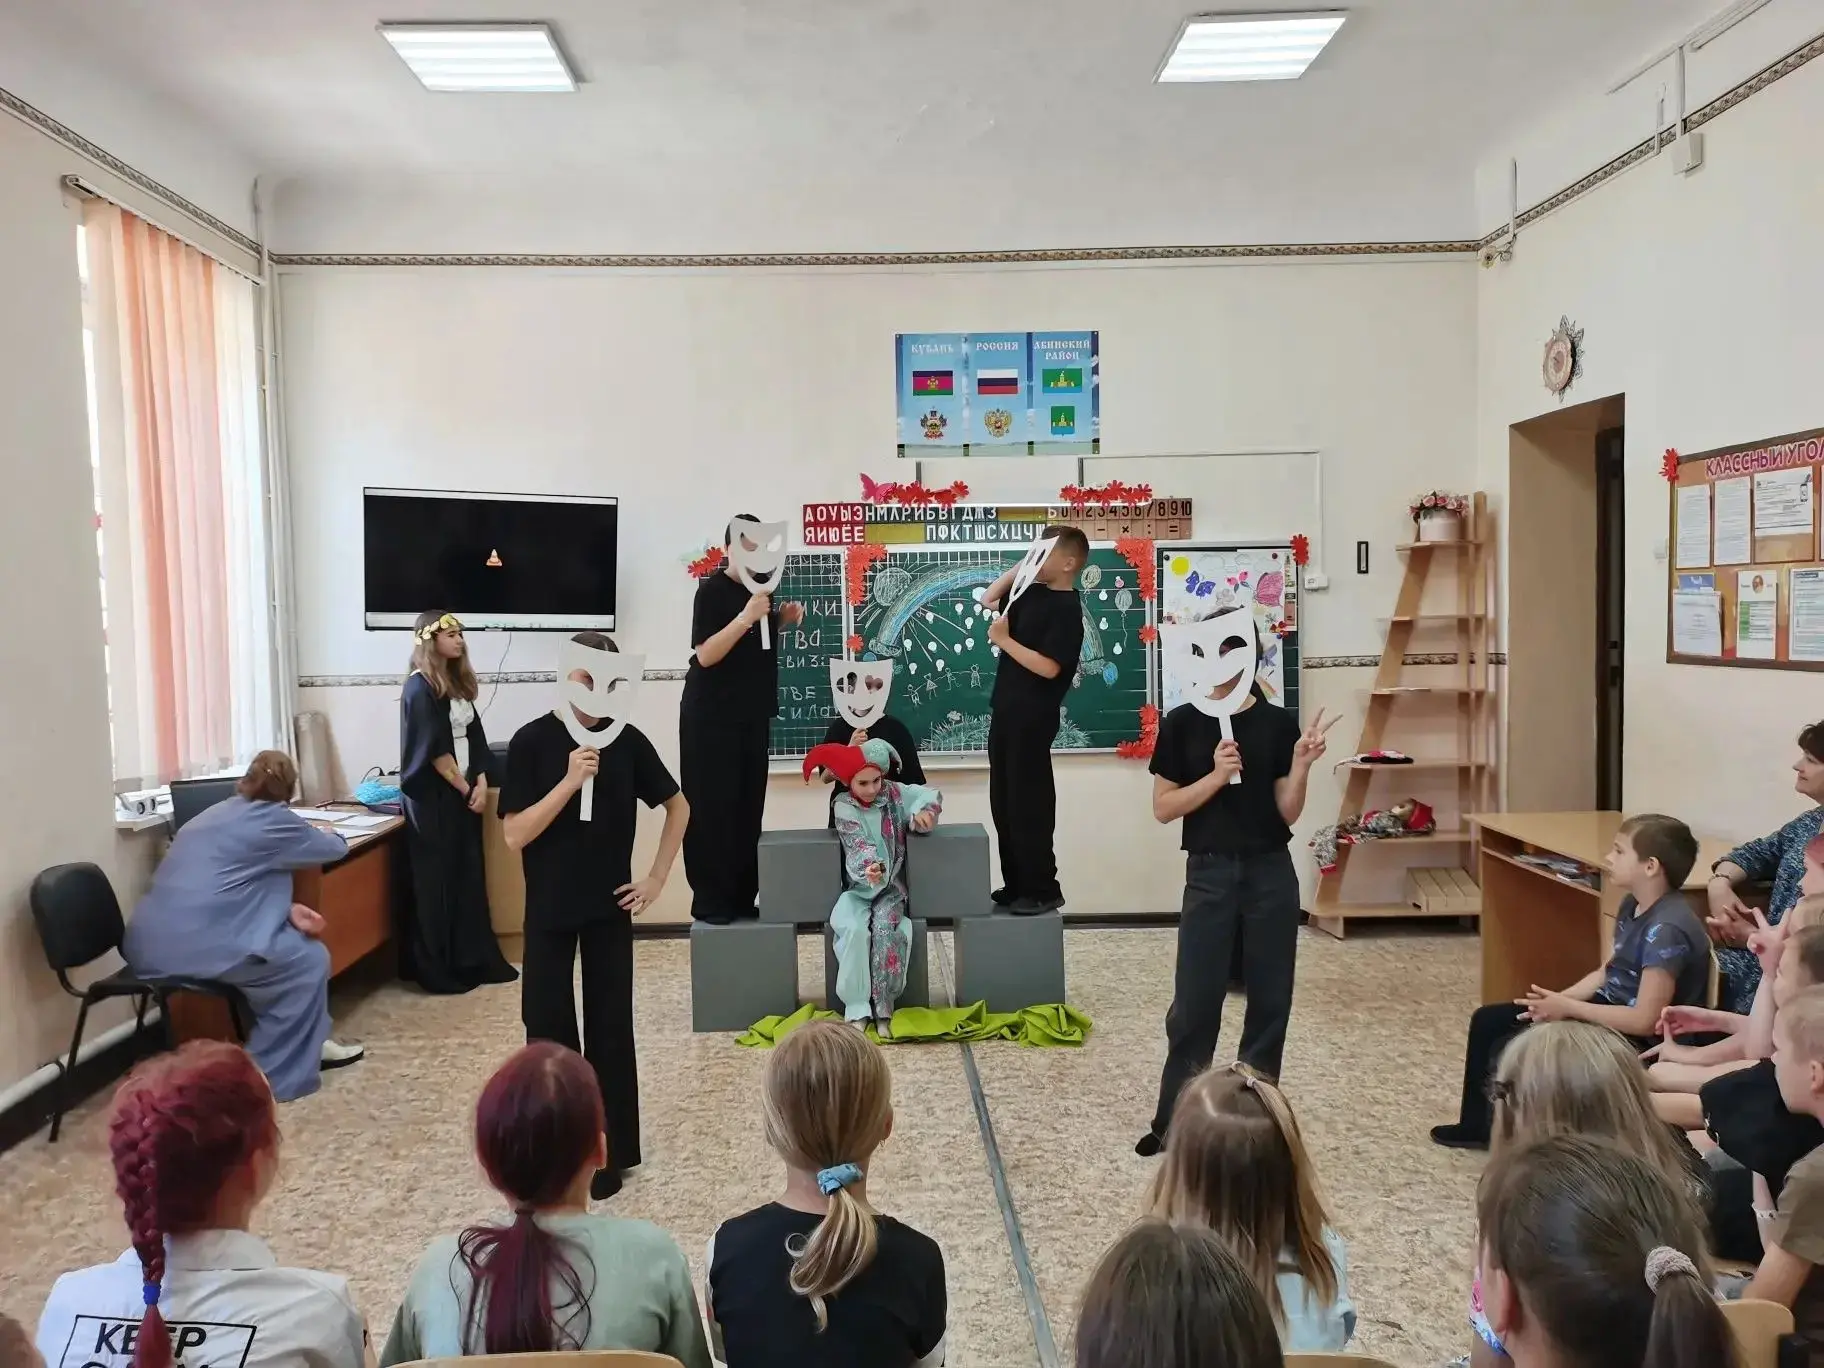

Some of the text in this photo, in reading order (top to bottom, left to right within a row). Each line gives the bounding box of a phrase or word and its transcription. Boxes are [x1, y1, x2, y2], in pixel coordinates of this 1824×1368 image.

[976, 341, 1018, 351] РОССИЯ
[1032, 340, 1090, 350] АБИНСКИЙ
[1045, 350, 1079, 360] РАЙОН
[94, 1322, 207, 1358] KEP
